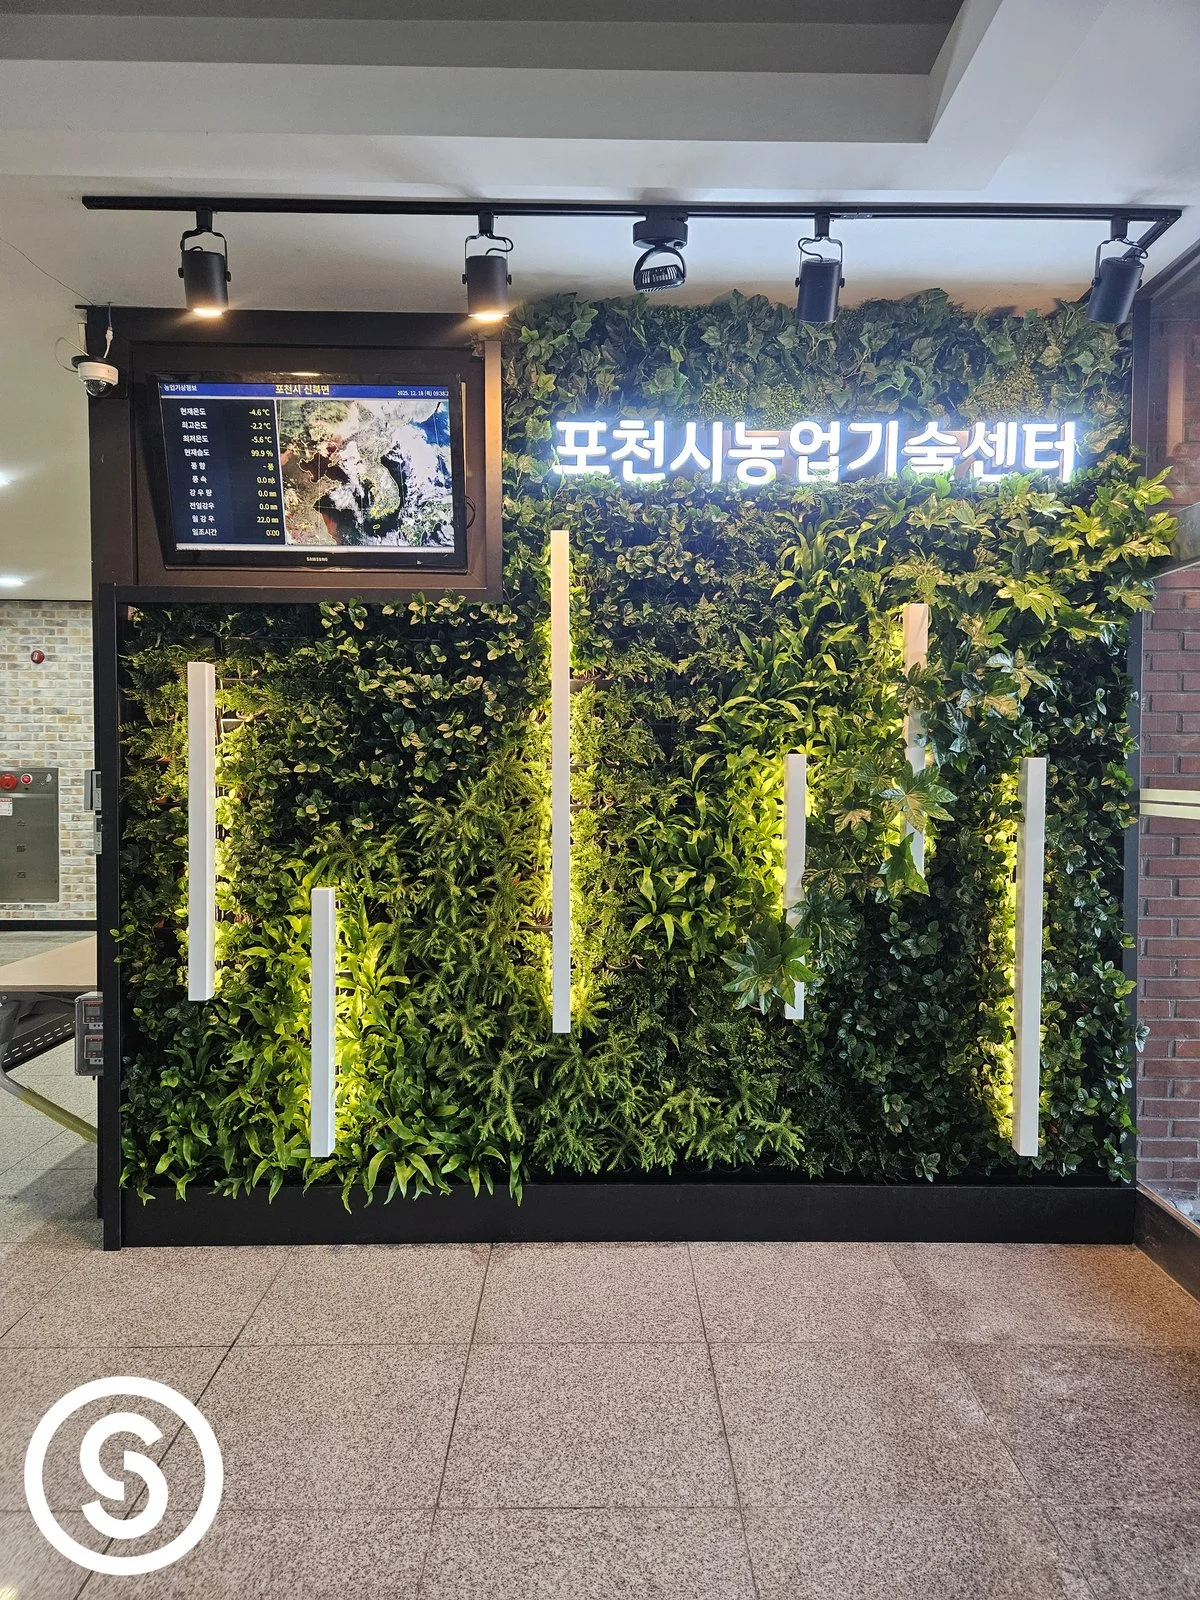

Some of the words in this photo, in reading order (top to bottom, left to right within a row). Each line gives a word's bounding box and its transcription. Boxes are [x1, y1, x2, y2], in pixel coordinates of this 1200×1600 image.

[275, 384, 301, 396] 포천시
[180, 408, 206, 416] 현재온도
[182, 435, 209, 443] 최저온도
[553, 419, 1078, 485] 포천시농업기술센터
